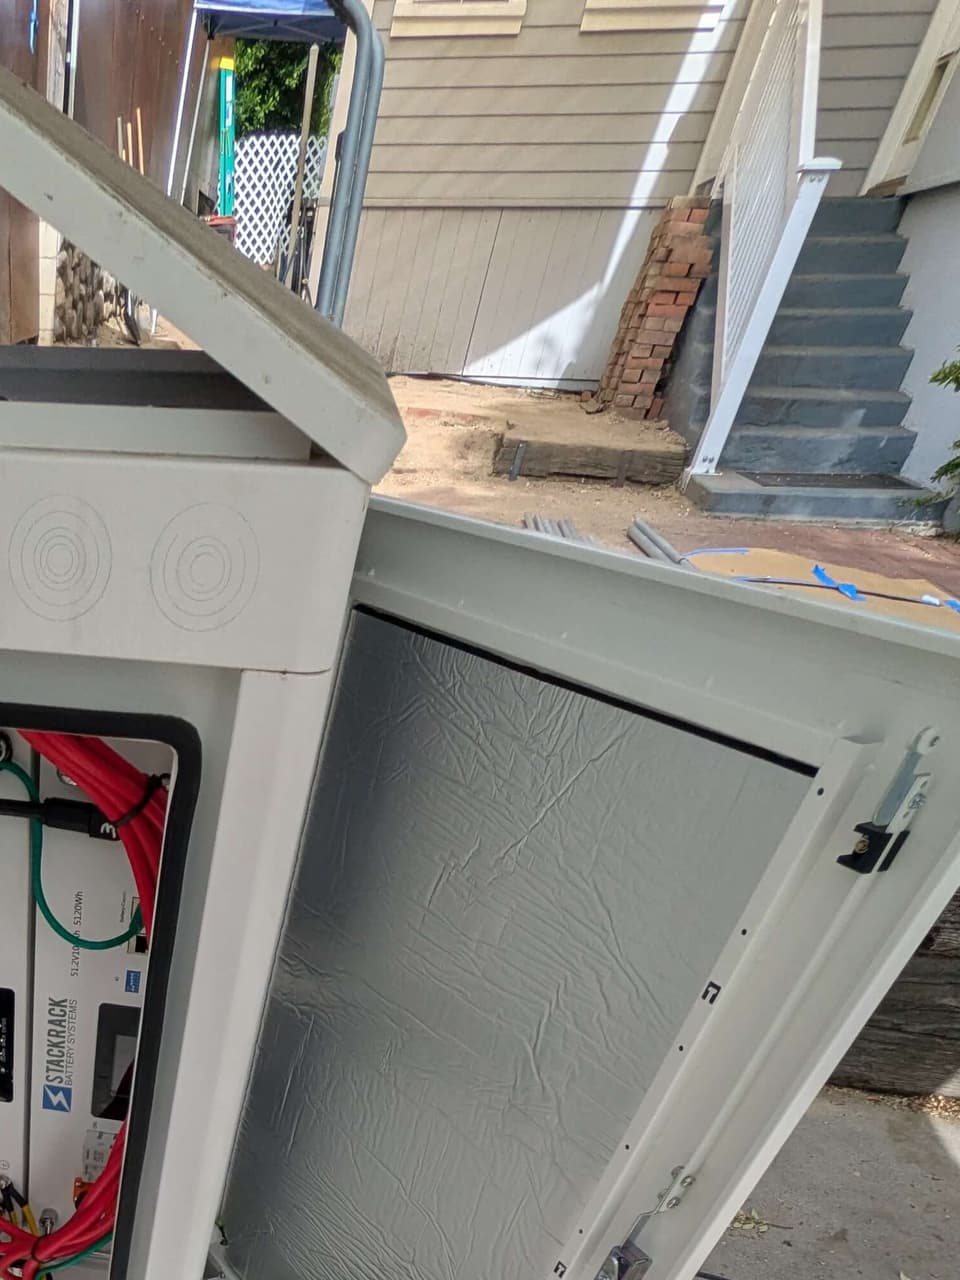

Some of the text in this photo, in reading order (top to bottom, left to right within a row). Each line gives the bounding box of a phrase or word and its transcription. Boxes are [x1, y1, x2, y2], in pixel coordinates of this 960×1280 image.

[100, 821, 117, 839] 3
[70, 890, 84, 977] 51.2V10h 5120Wh
[45, 996, 68, 1085] STACKRACK
[64, 999, 78, 1086] BATTERY SYSTEMS
